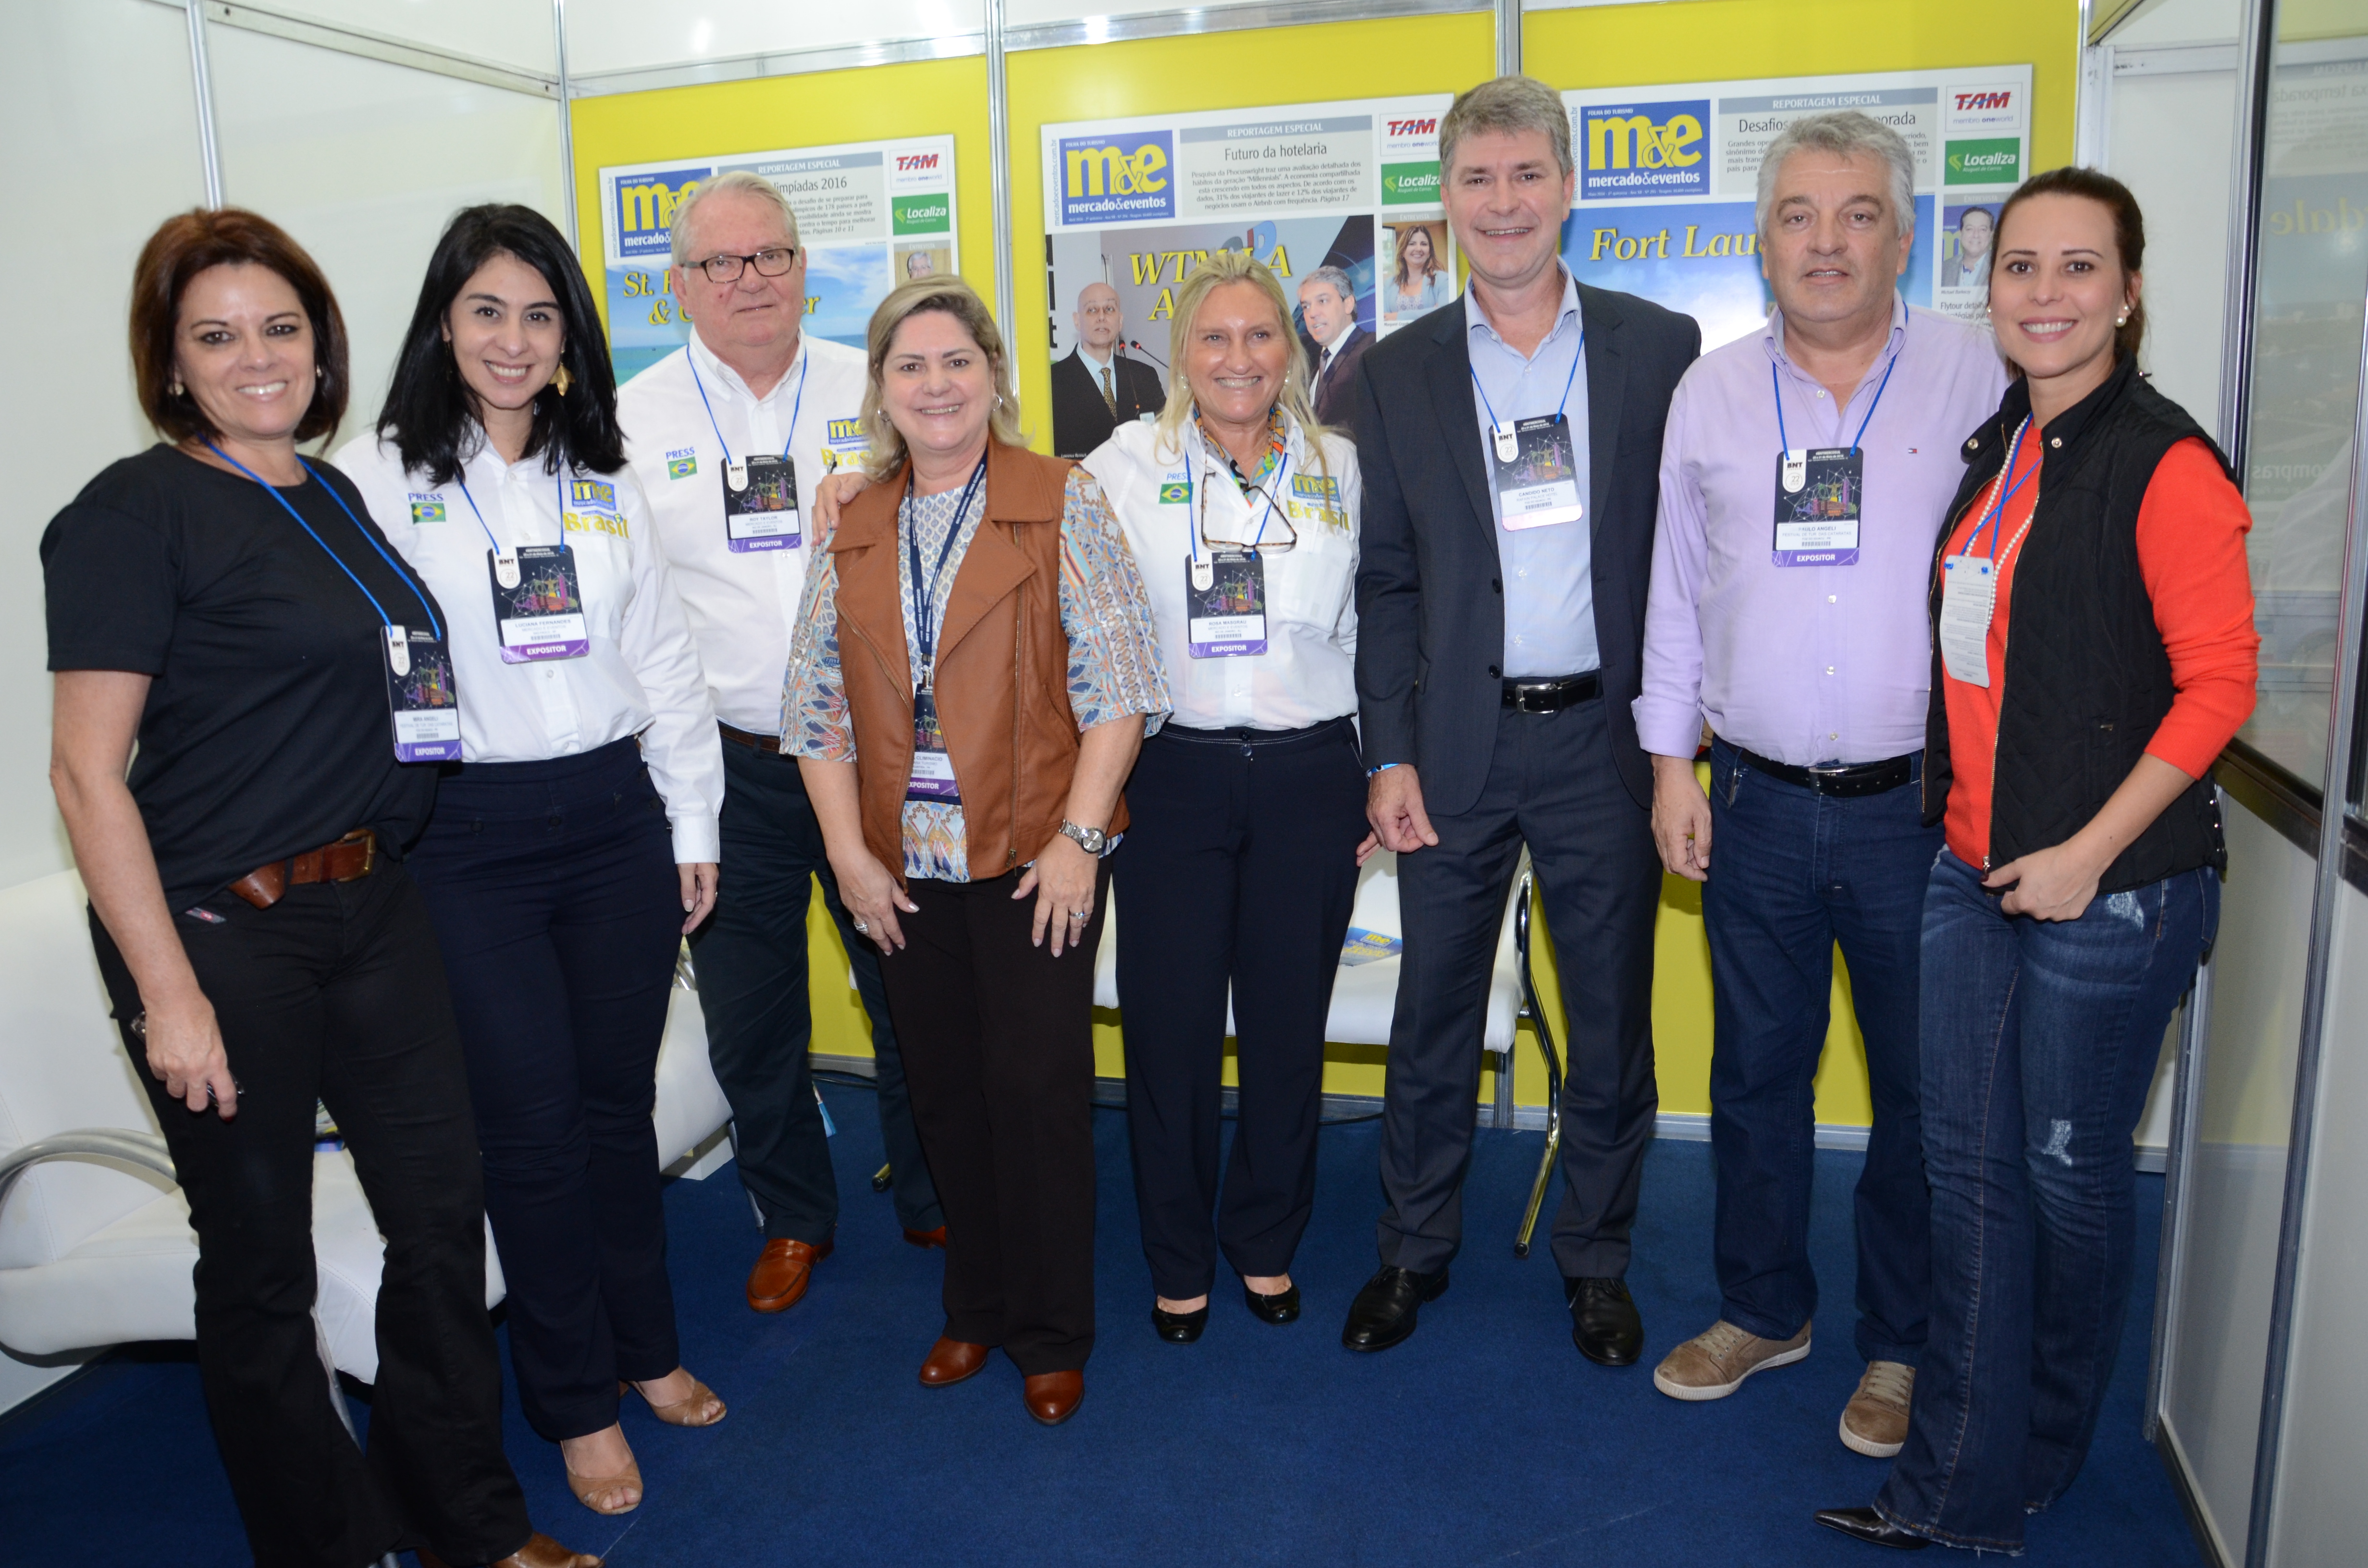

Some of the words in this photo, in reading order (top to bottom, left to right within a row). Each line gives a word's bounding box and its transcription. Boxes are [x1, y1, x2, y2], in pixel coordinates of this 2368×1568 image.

[1773, 98, 1835, 109] REPORTAGEM
[1838, 95, 1882, 106] ESPECIAL
[1954, 91, 2011, 110] TAM
[1227, 125, 1283, 138] REPORTAGEM
[1285, 122, 1323, 134] ESPECIAL
[1387, 118, 1437, 136] TAM
[1588, 113, 1703, 171] m&e
[1225, 147, 1259, 161] Futuro
[1263, 146, 1276, 159] da
[1280, 142, 1327, 157] hotelaria
[1964, 151, 2016, 167] Localiza
[758, 161, 806, 174] REPORTAGEM
[807, 159, 840, 170] ESPECIAL
[896, 153, 939, 172] TAM
[1191, 171, 1216, 179] Pesquisa
[1226, 167, 1264, 176] Phocuswright
[1320, 161, 1349, 170] detalhada
[1066, 143, 1168, 198] m&e
[1223, 177, 1246, 185] geração
[1319, 169, 1361, 178] compartilhada
[774, 178, 818, 195] limpíadas
[821, 176, 847, 190] 2016
[1588, 171, 1701, 188] mercado&eventos
[833, 195, 855, 204] preparar
[1241, 192, 1266, 200] viajantes
[1322, 186, 1349, 195] viajantes
[859, 201, 873, 209] partir
[1068, 196, 1167, 215] mercado&eventos
[1204, 203, 1230, 211] negócios
[1320, 195, 1340, 203] Página
[906, 205, 947, 219] Localiza
[799, 220, 815, 228] contra
[821, 219, 838, 228] tempo
[839, 219, 851, 227] para
[852, 216, 876, 224] melhorar
[812, 226, 833, 235] Páginas
[1588, 227, 1671, 261] Fort
[1940, 302, 1963, 311] Flytour
[665, 446, 695, 460] PRESS
[407, 492, 444, 502] PRESS
[562, 511, 629, 539] Brasil
[749, 540, 783, 549] EXPOSITOR
[1797, 553, 1836, 563] EXPOSITOR
[527, 645, 567, 656] EXPOSITOR
[1211, 645, 1247, 653] EXPOSITOR
[415, 747, 446, 756] EXPOSITOR
[909, 781, 939, 790] XPOSITOR
